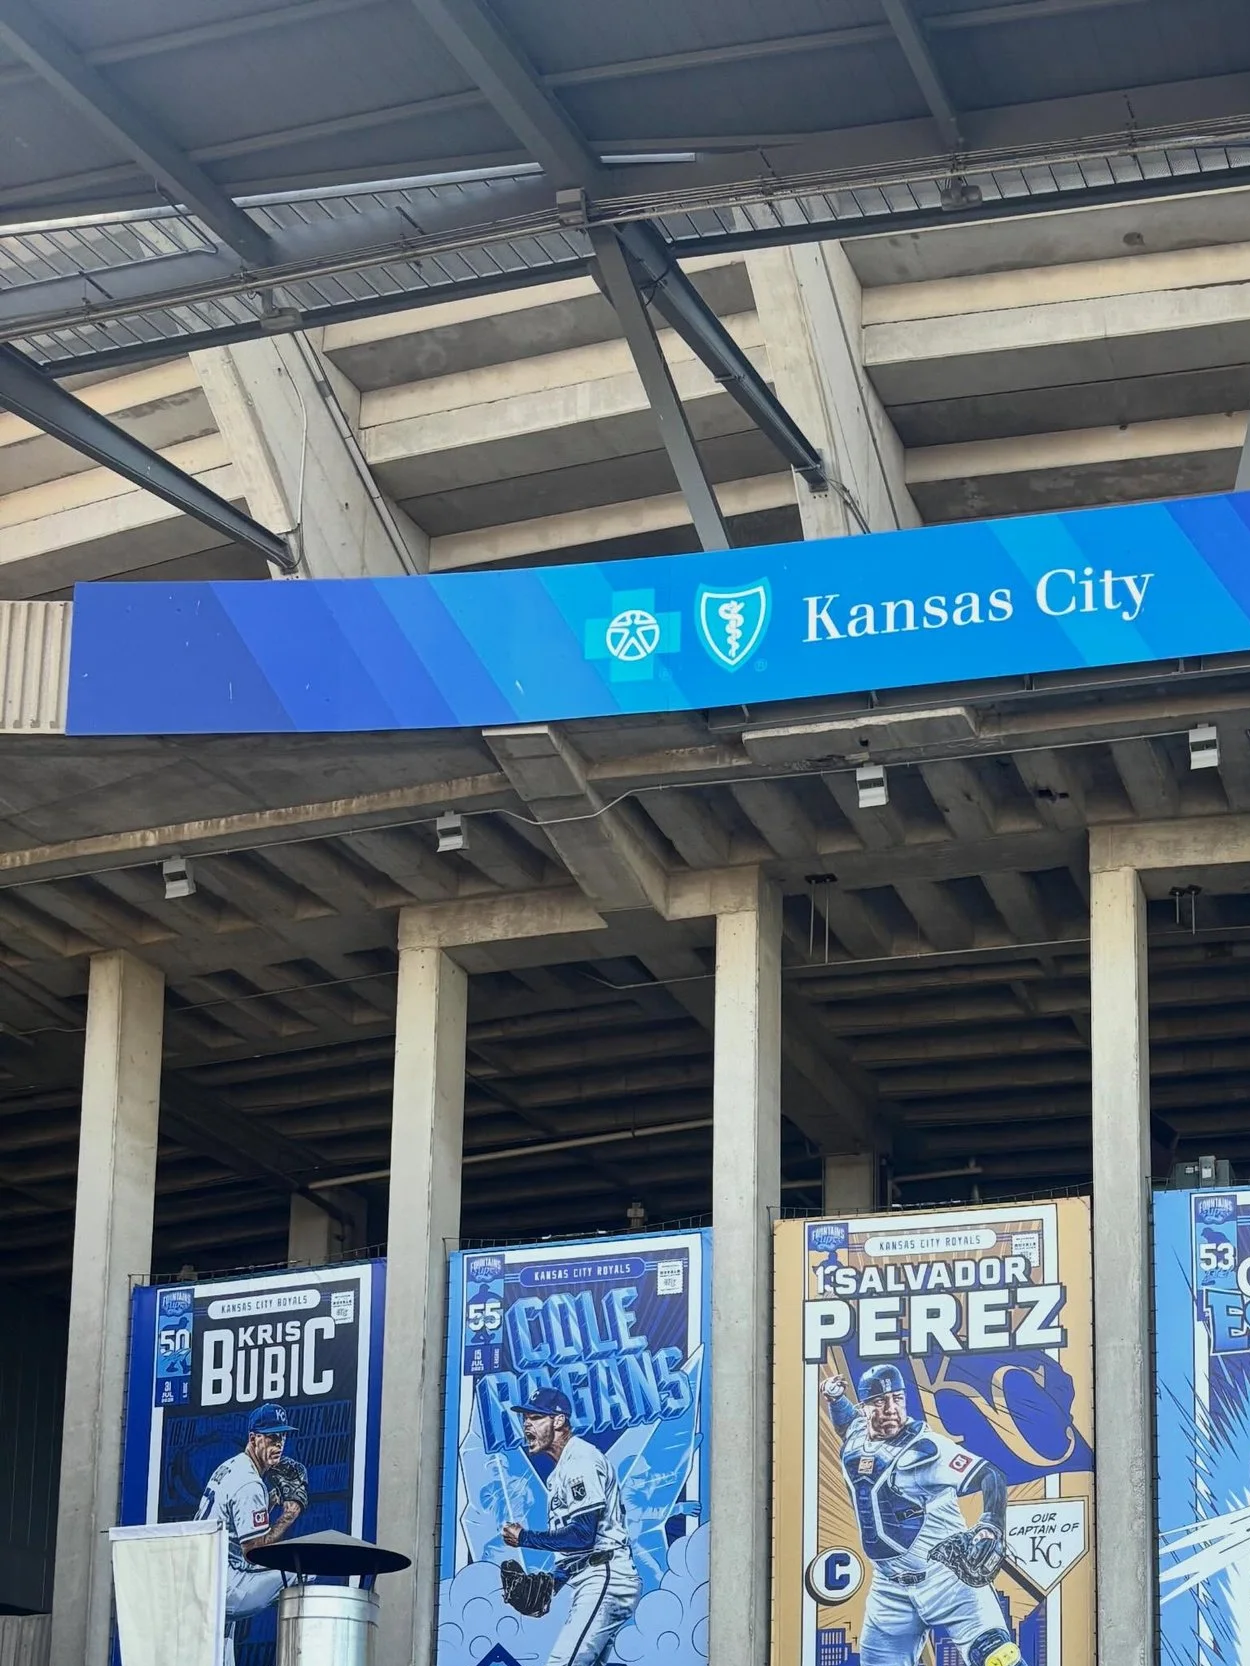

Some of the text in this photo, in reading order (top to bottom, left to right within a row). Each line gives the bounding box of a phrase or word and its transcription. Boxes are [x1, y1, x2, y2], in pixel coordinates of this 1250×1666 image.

[802, 566, 1154, 643] Kansas City
[880, 1235, 981, 1251] KANSAS CITY ROYALS
[1200, 1243, 1237, 1272] 53
[534, 1264, 631, 1281] KANSAS CITY ROYALS
[834, 1256, 1029, 1296] SALVADOR
[221, 1296, 308, 1314] KANSAS CITY ROYALS
[468, 1302, 502, 1331] 55
[238, 1320, 301, 1348] KRIS
[505, 1287, 648, 1371] COLE
[803, 1283, 1066, 1361] PEREZ
[160, 1329, 191, 1354] 50
[201, 1316, 336, 1406] BUBIC
[471, 1360, 484, 1368] JUL
[1008, 1522, 1080, 1537] CAPTAIN OF
[1031, 1512, 1057, 1523] OUR
[1029, 1536, 1063, 1568] KC
[825, 1553, 850, 1590] C
